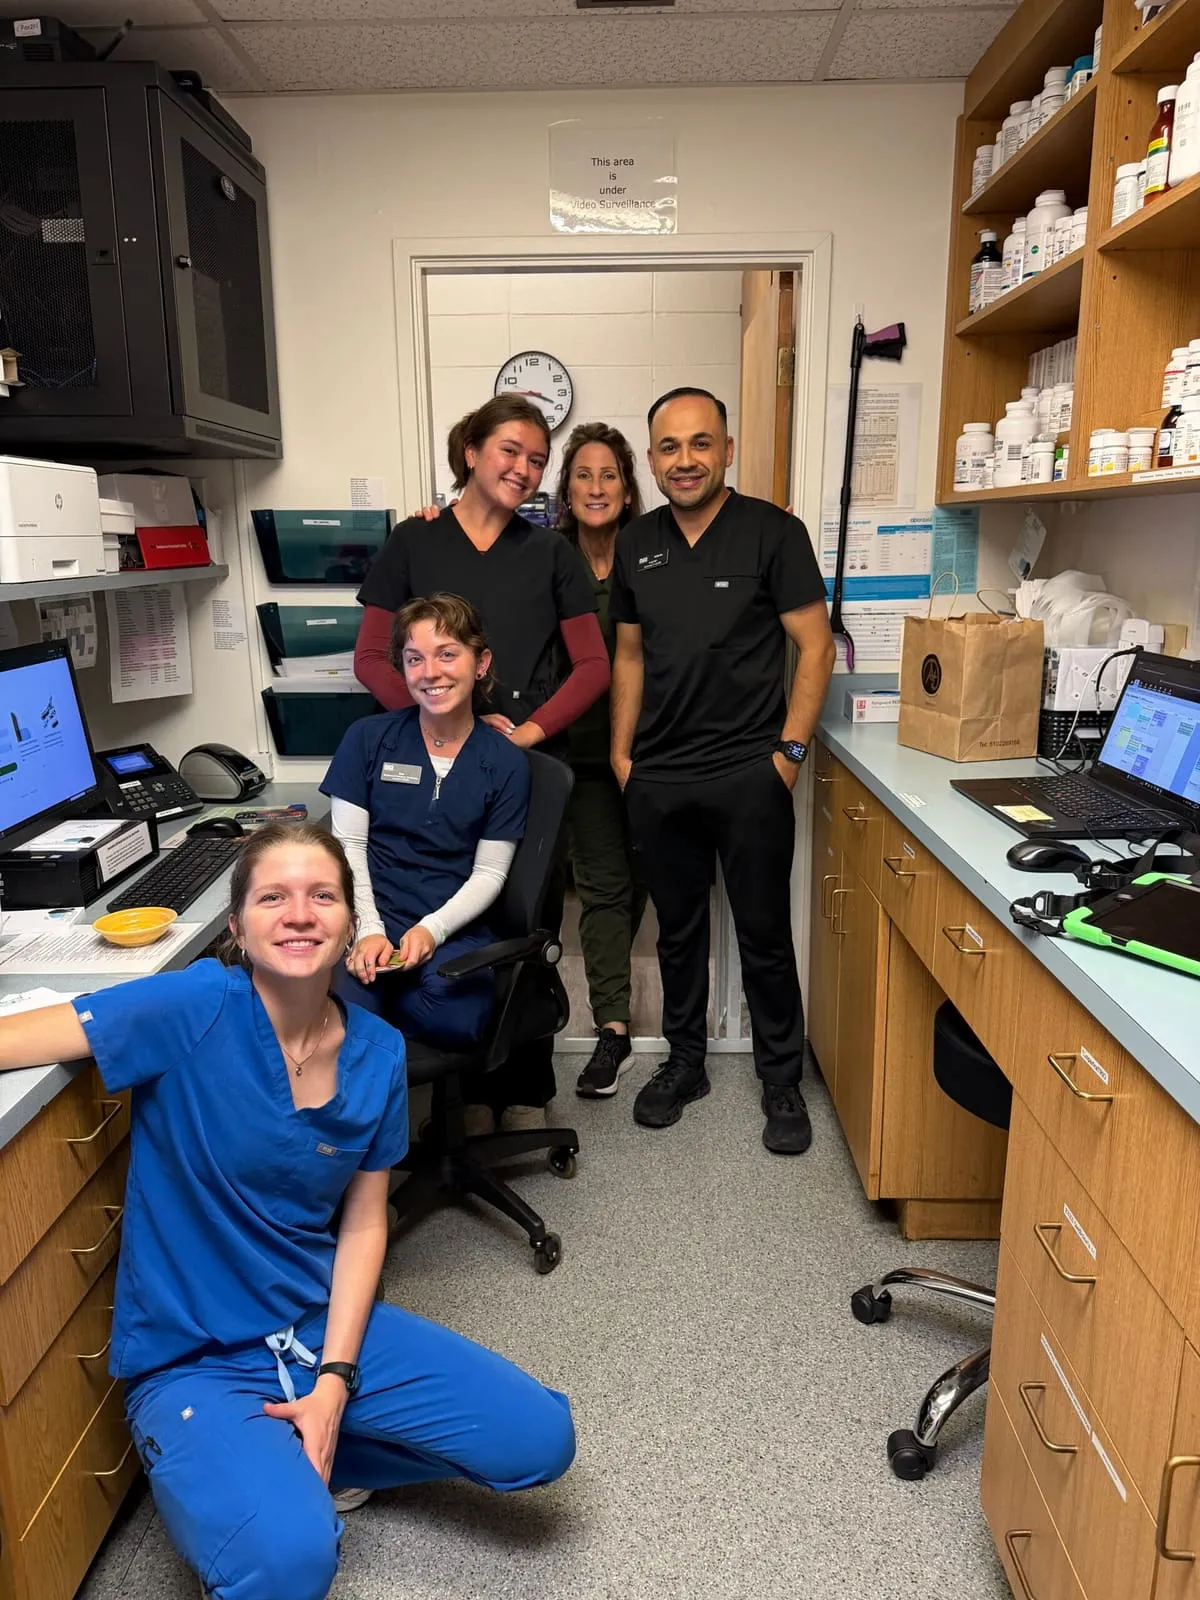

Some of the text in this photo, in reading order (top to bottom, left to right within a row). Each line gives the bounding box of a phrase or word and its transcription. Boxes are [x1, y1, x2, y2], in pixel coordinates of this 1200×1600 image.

[591, 157, 635, 167] This area
[609, 172, 617, 181] is
[599, 186, 628, 195] under
[571, 199, 657, 209] Video Surveillance
[525, 357, 540, 367] 12
[513, 364, 523, 374] 11
[547, 362, 552, 372] 1
[504, 376, 518, 385] 10
[552, 374, 563, 383] 2
[557, 388, 568, 397] 3
[554, 403, 564, 412] 4
[546, 415, 556, 424] 5
